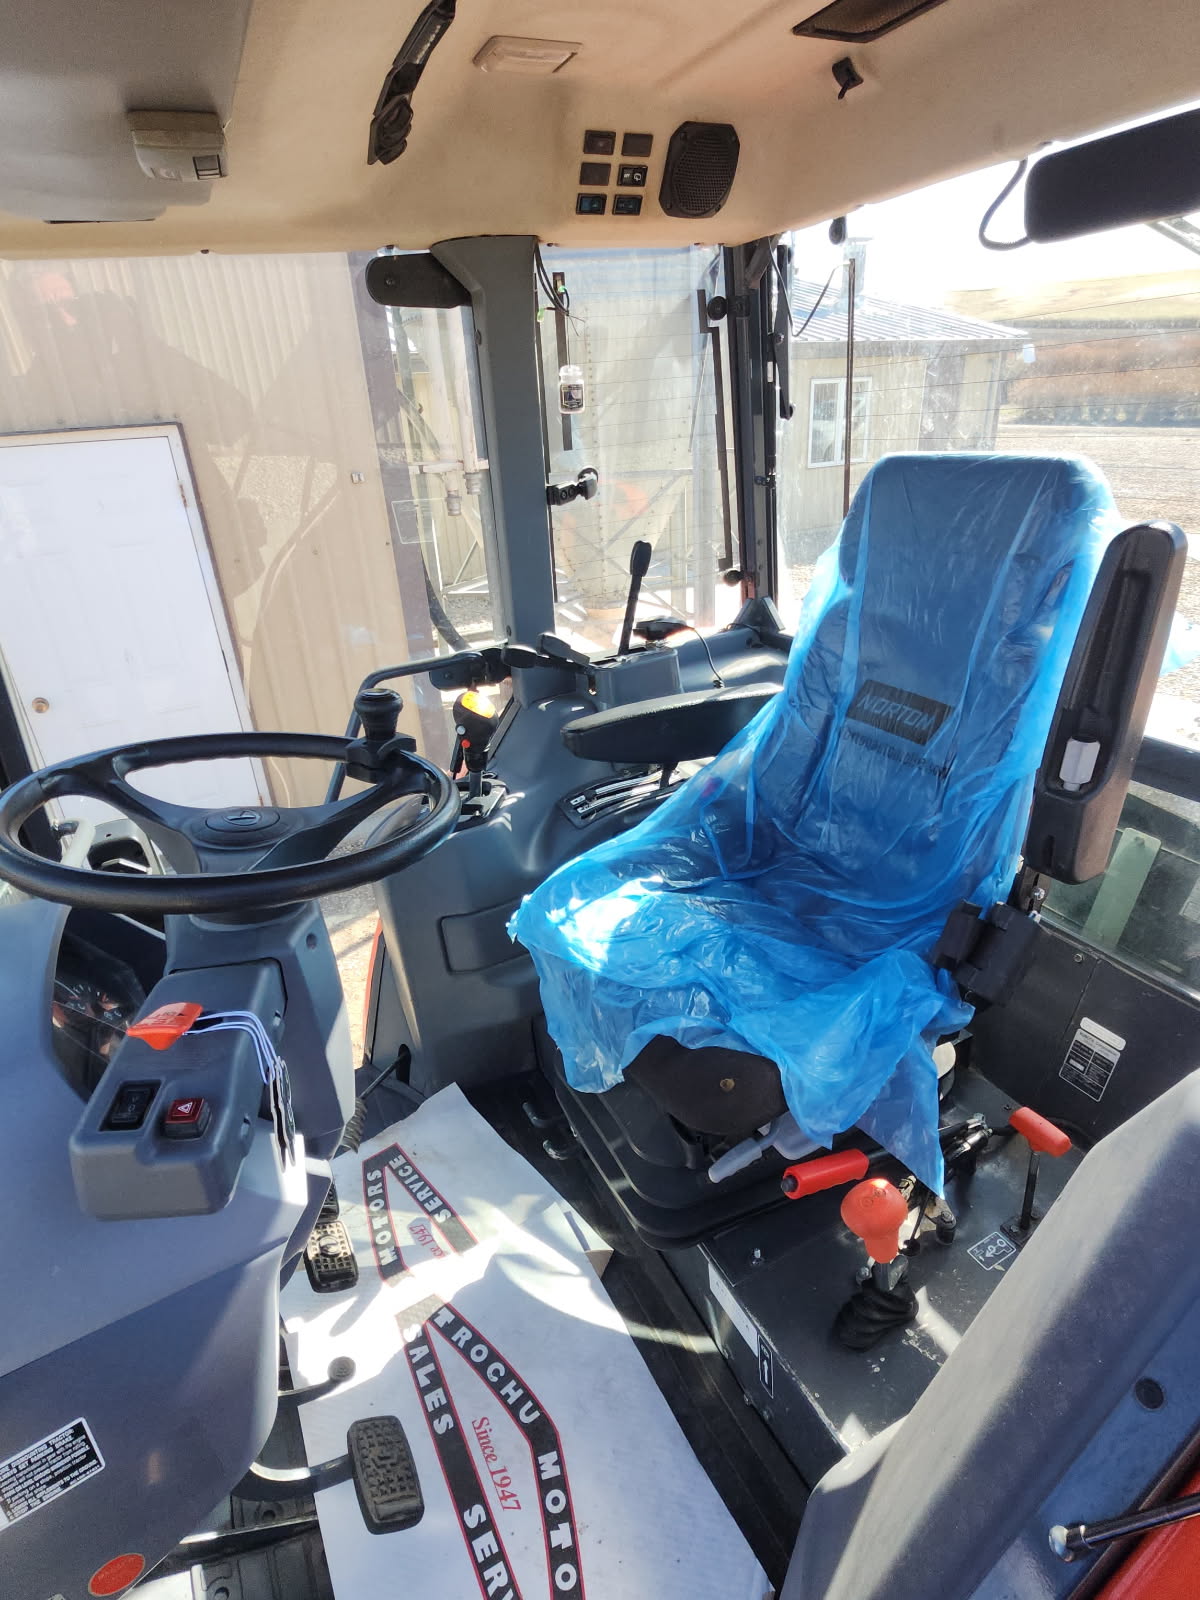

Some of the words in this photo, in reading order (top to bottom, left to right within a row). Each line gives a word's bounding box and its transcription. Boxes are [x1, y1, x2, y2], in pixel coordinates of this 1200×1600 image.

[856, 694, 937, 731] NORTON
[366, 1169, 398, 1266] MOTORS
[388, 1154, 452, 1224] SERVICE
[433, 1306, 540, 1424] TROCHU
[538, 1451, 577, 1591] MOTO
[471, 1416, 498, 1463] Since
[490, 1464, 522, 1511] 1947
